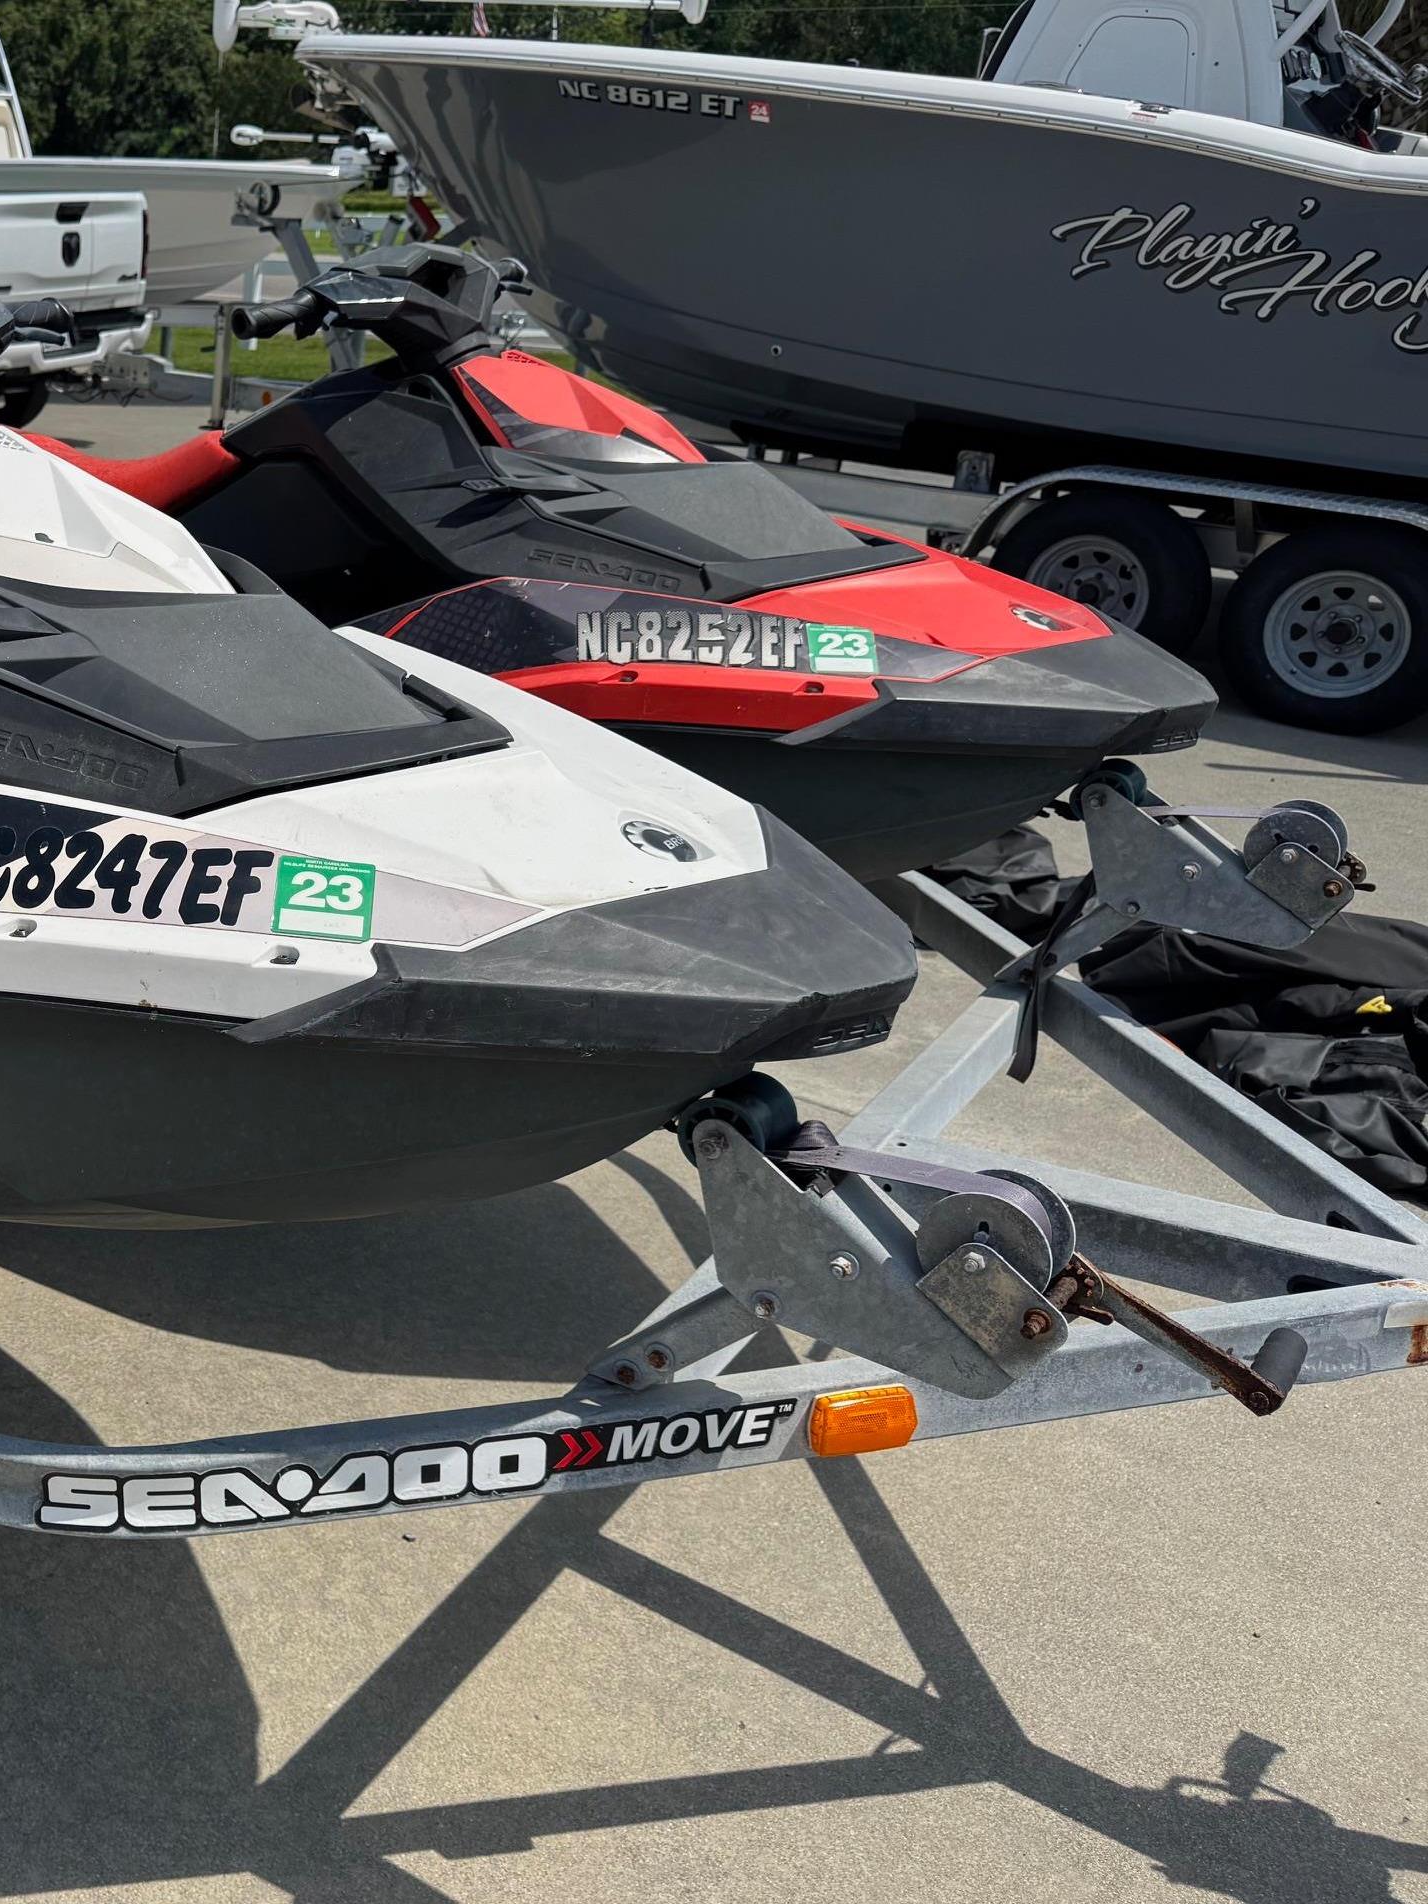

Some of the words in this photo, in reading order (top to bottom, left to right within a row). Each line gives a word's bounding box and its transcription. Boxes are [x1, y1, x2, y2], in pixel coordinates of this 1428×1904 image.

[557, 79, 599, 100] NC
[606, 84, 690, 112] 8612
[699, 93, 741, 118] ET
[750, 104, 768, 117] 24
[1051, 198, 1316, 291] Playin'
[576, 609, 803, 668] NC8252EF
[817, 632, 870, 657] 23
[288, 870, 364, 911] 23
